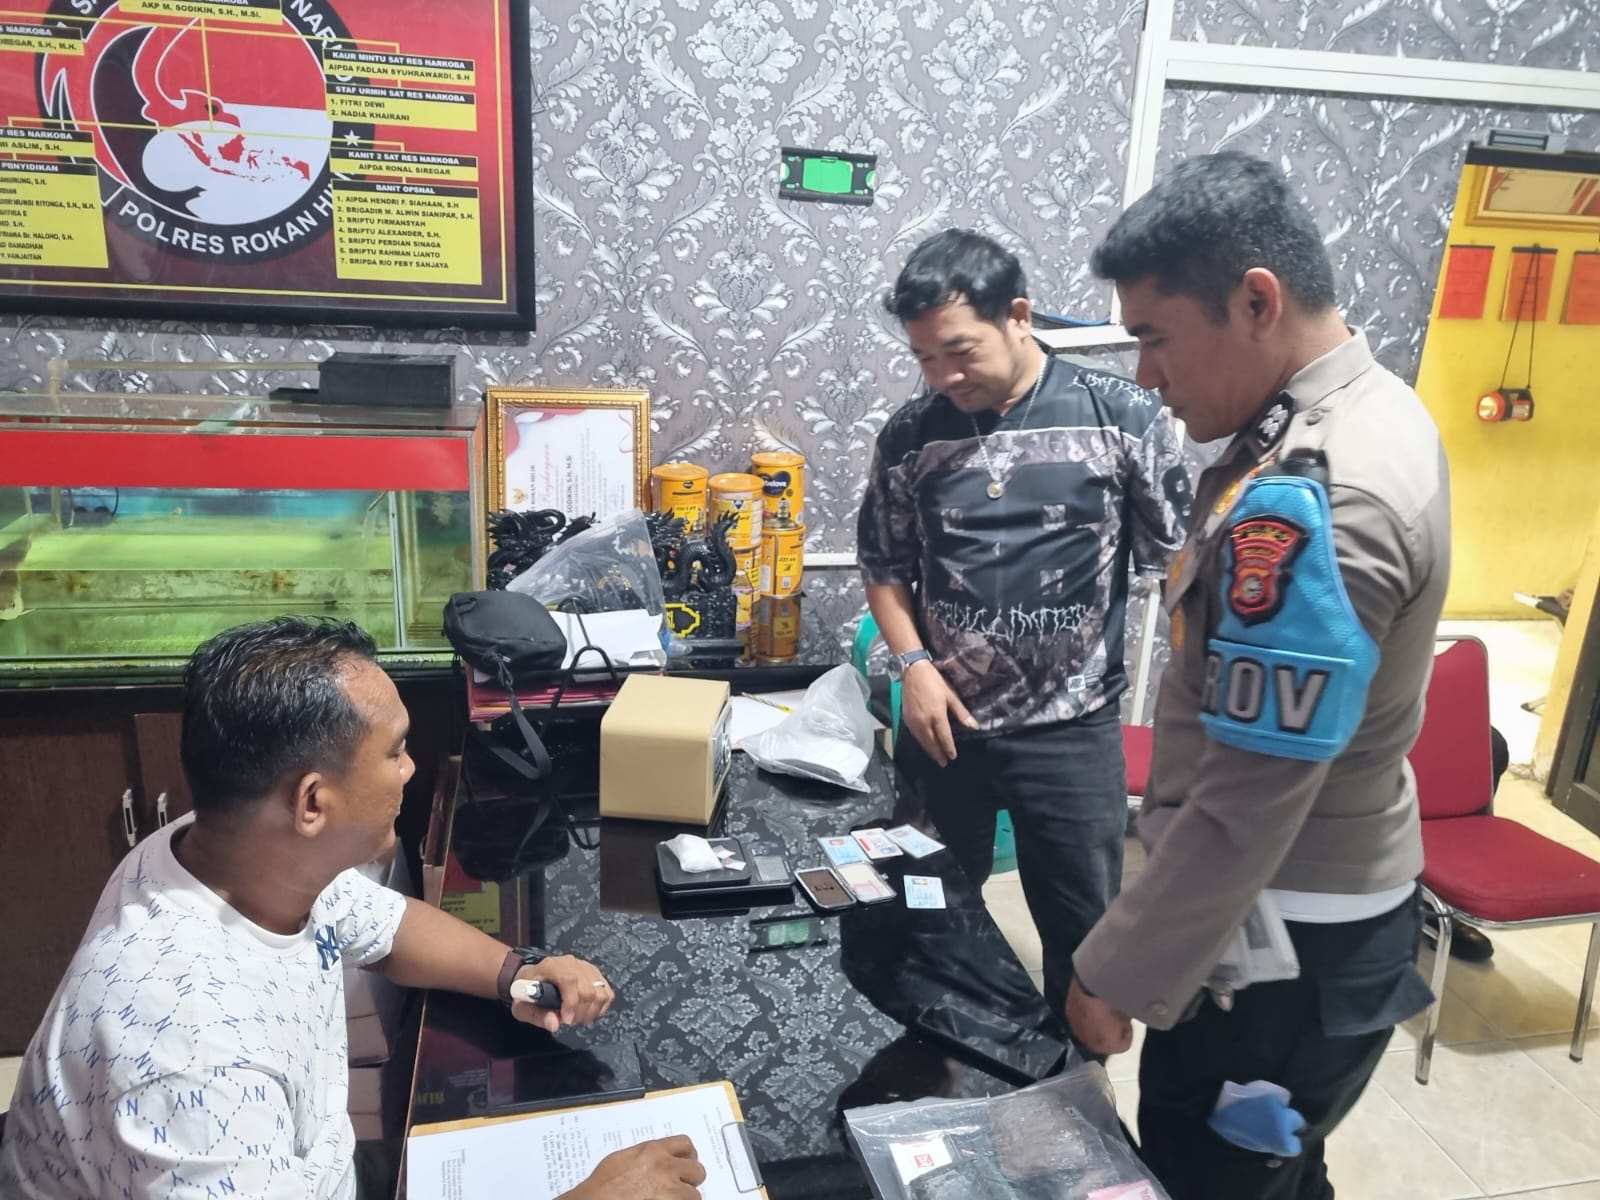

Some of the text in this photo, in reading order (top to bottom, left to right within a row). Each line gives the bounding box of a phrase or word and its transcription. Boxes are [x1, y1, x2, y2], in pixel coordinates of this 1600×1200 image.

[142, 1, 160, 9] AKP
[175, 4, 216, 15] SODIKIN,
[5, 26, 53, 35] NARKOBA
[332, 51, 466, 69] KAUR MINTU SAT RES NARKOBA
[328, 63, 354, 71] AIPDA
[356, 65, 388, 74] FADLAN
[335, 85, 466, 102] STAF URMIN SAT RES NARKOBA
[340, 99, 362, 107] FITRI
[341, 110, 367, 118] NADIA
[369, 112, 410, 121] KHAIRANI
[27, 130, 73, 140] NARKOBA
[11, 142, 43, 151] ASLIM,
[45, 143, 63, 151] S.H.
[348, 151, 374, 159] KANIT
[419, 156, 460, 165] NARKOBA
[1, 162, 59, 172] PENYIDIKAN
[358, 163, 451, 175] AIPDA RONAL SIREGAR
[375, 184, 436, 194] BANIT OPSNAL
[409, 199, 445, 208] SIAHAAN,
[346, 206, 383, 214] BRIGADIR
[421, 210, 458, 219] SIANIPAR,
[119, 200, 225, 255] POLRES
[231, 210, 319, 255] ROKAN
[377, 218, 426, 227] FIRMANSYAH
[347, 227, 376, 235] BRIPTU
[378, 229, 425, 238] ALEXANDER,
[348, 237, 376, 245] BRIPTU
[413, 240, 441, 248] SINAGA
[348, 247, 377, 255] BRIPTU
[378, 249, 411, 257] RAHMAN
[415, 261, 449, 269] SANJAYA
[315, 924, 340, 970] NY
